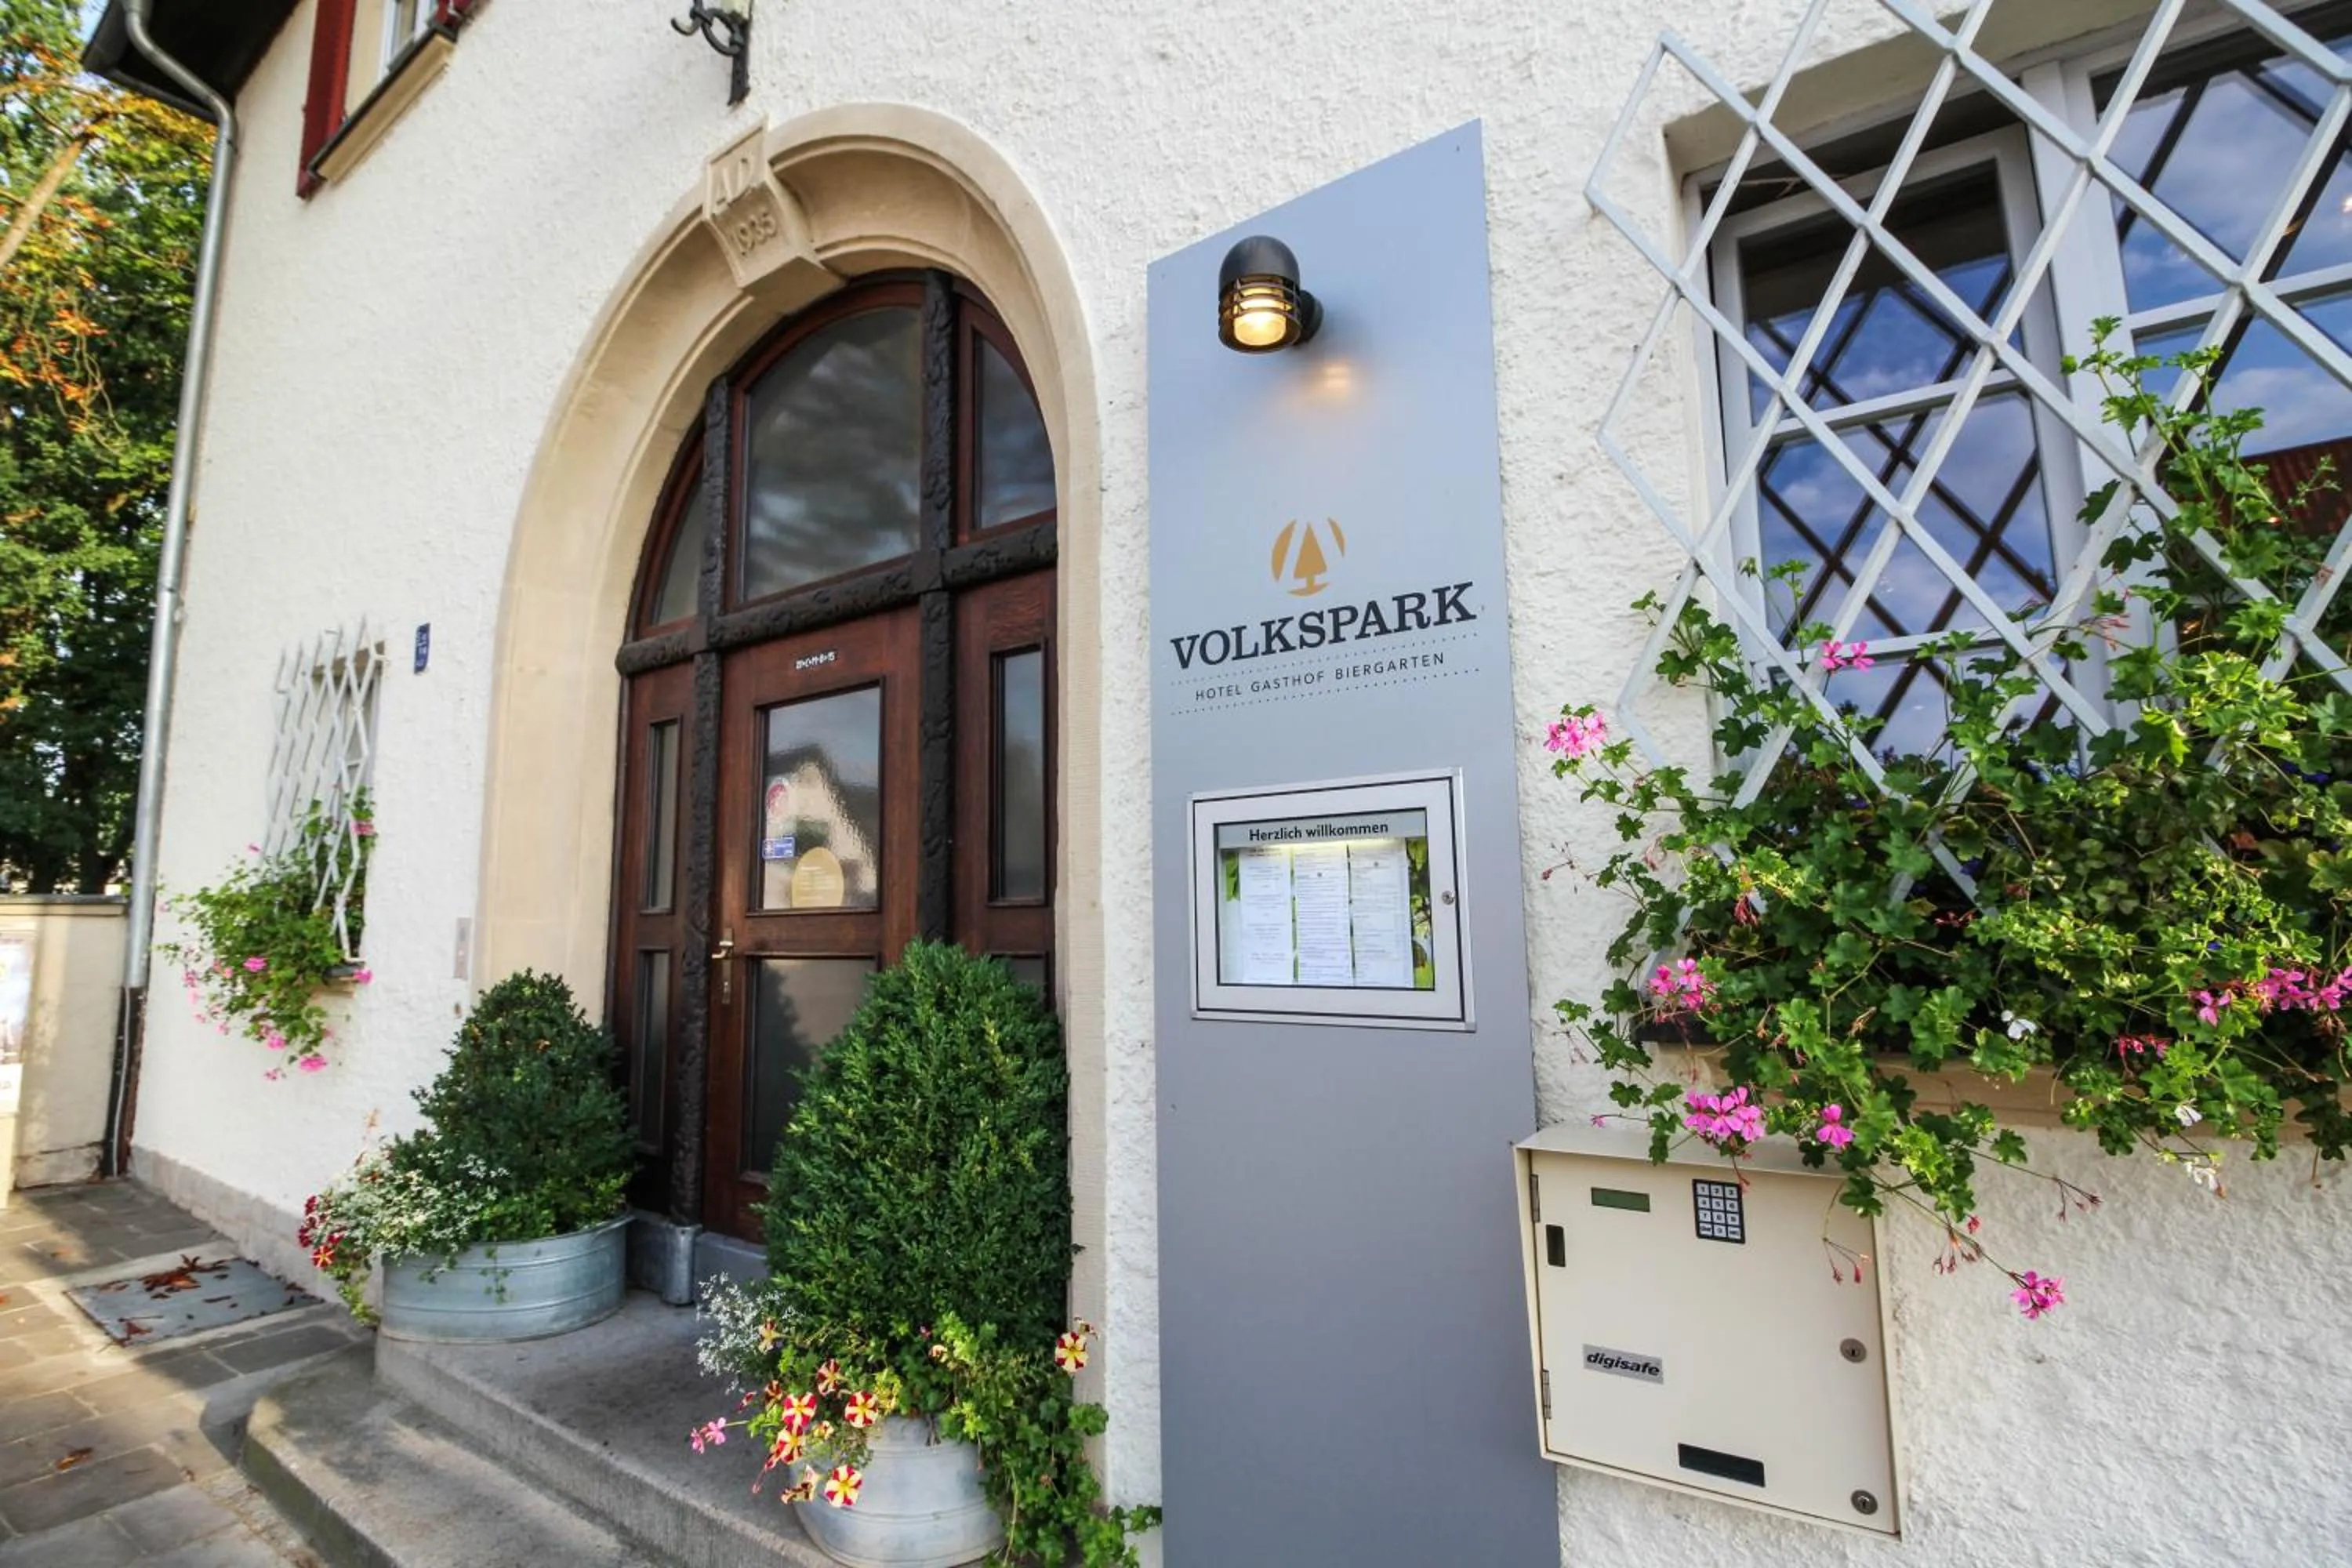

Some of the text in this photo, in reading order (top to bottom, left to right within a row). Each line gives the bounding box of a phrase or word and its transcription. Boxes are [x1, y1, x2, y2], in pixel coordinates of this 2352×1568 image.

[1170, 581, 1477, 670] VOLKSPARK
[1195, 652, 1445, 701] HOTEL GASTHOF BIERGARTEN
[1249, 823, 1388, 841] Herzlich willkommen
[1586, 1352, 1661, 1376] digisafe
